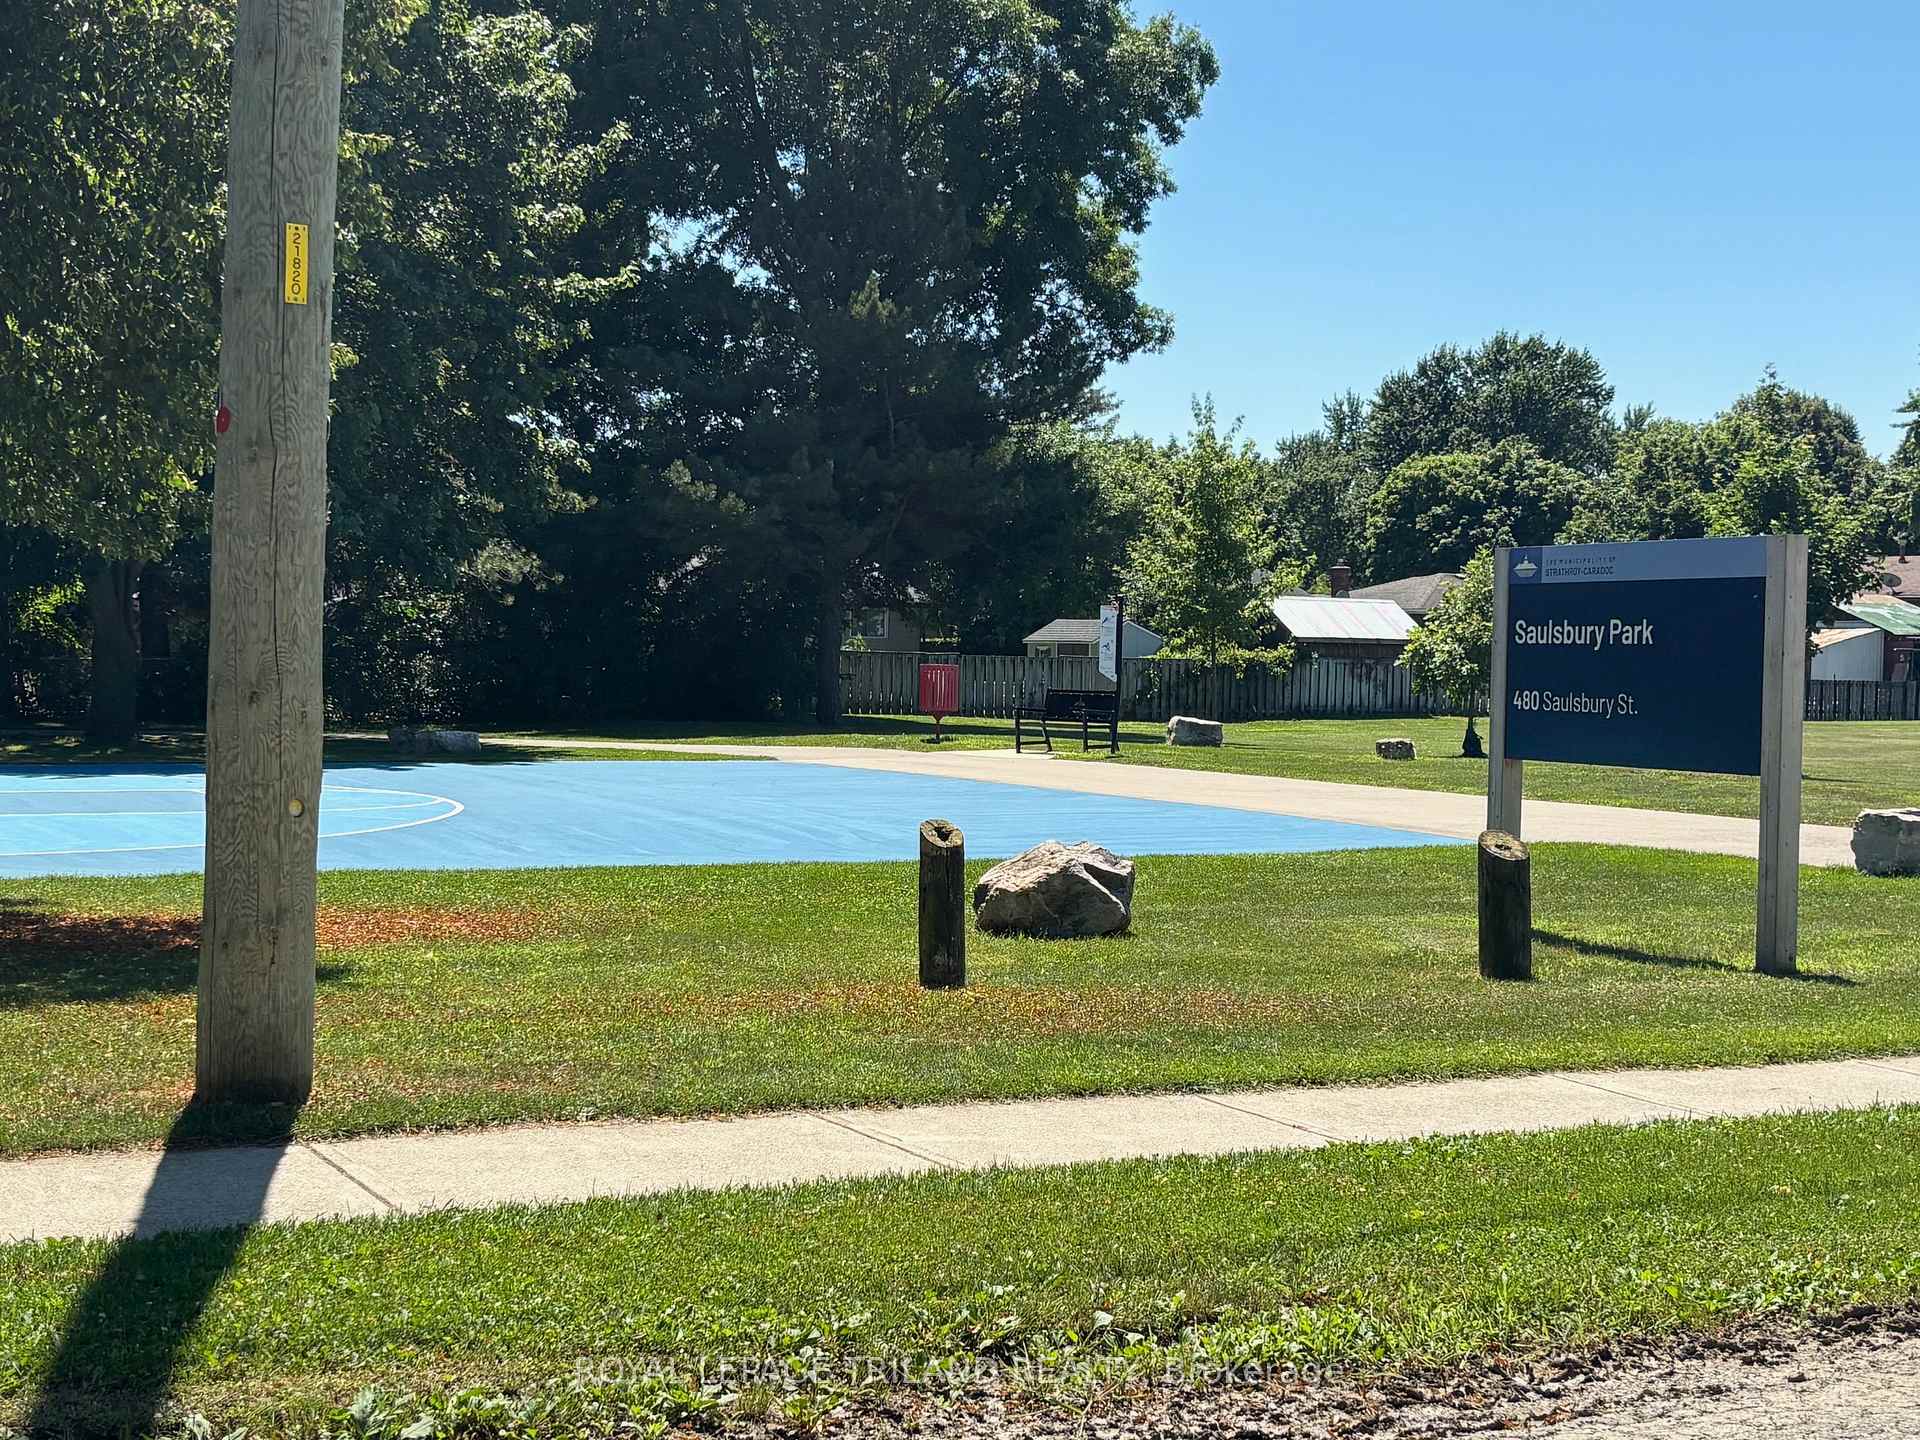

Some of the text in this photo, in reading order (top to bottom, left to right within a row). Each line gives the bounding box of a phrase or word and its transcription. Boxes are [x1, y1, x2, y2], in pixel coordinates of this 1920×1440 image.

[291, 232, 301, 295] 21820
[1515, 618, 1654, 651] Saulsbury Park
[1513, 690, 1638, 719] 480 Saulsbury St.
